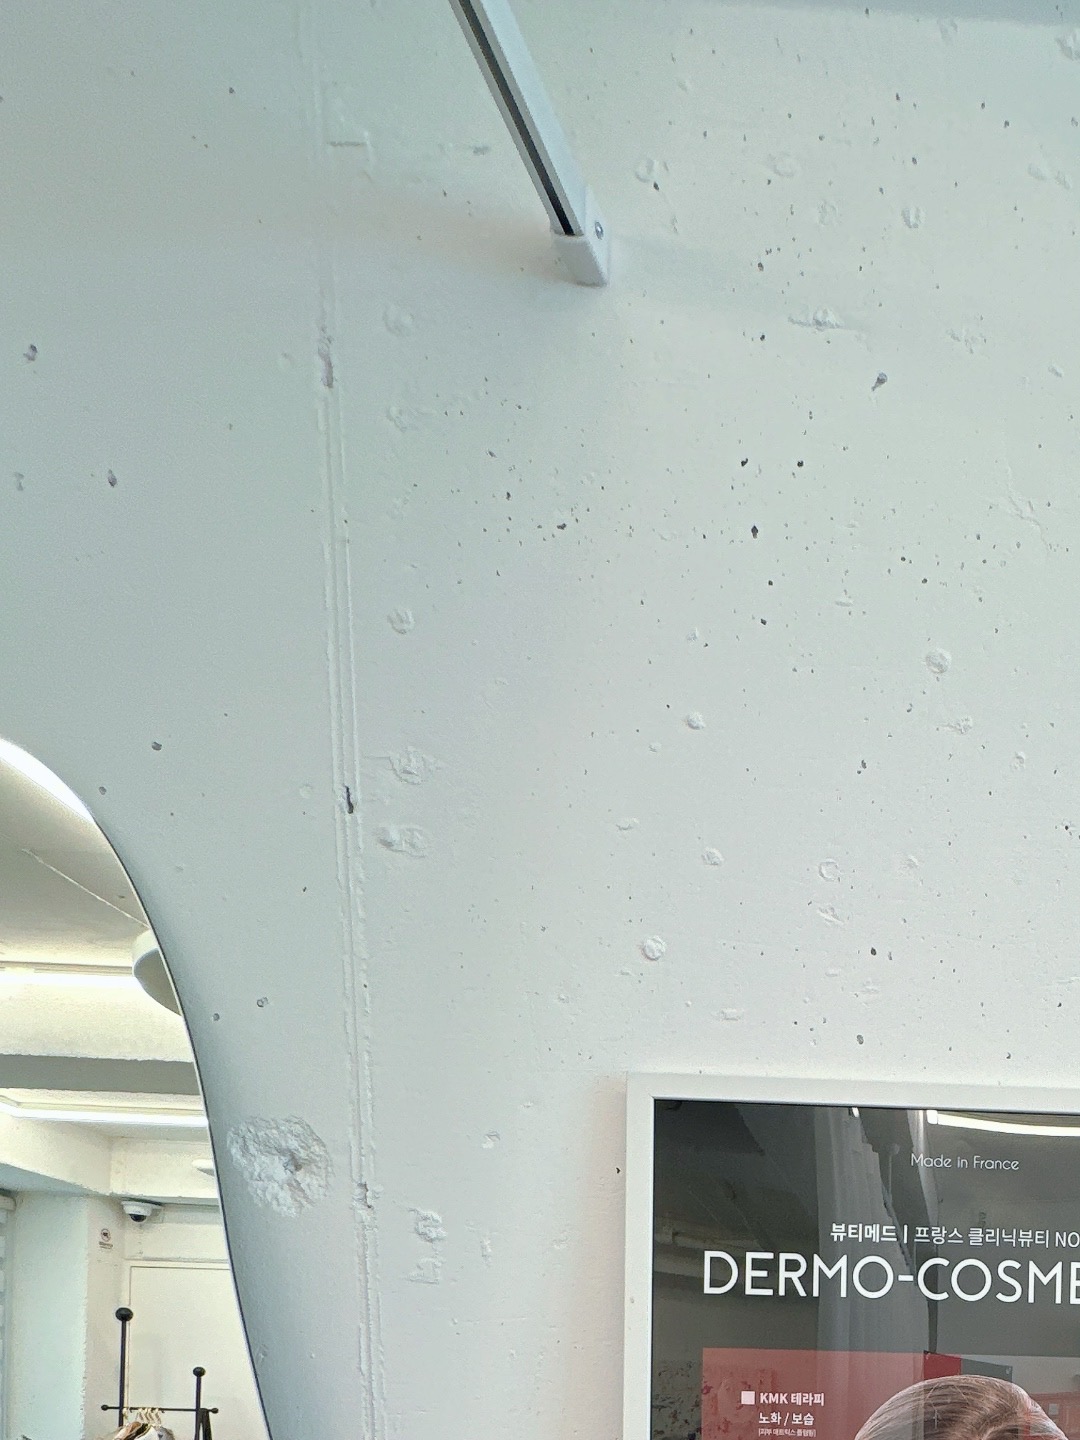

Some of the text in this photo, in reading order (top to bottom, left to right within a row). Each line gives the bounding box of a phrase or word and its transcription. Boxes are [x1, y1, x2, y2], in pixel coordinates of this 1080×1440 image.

[910, 1153, 1020, 1171] Made in France
[830, 1223, 898, 1243] 뷰티메드
[915, 1225, 963, 1245] 프랑스
[968, 1227, 1049, 1248] 클리닉뷰티
[760, 1392, 825, 1406] KMK 테라피
[759, 1412, 781, 1425] 노화
[792, 1413, 814, 1425] 보습
